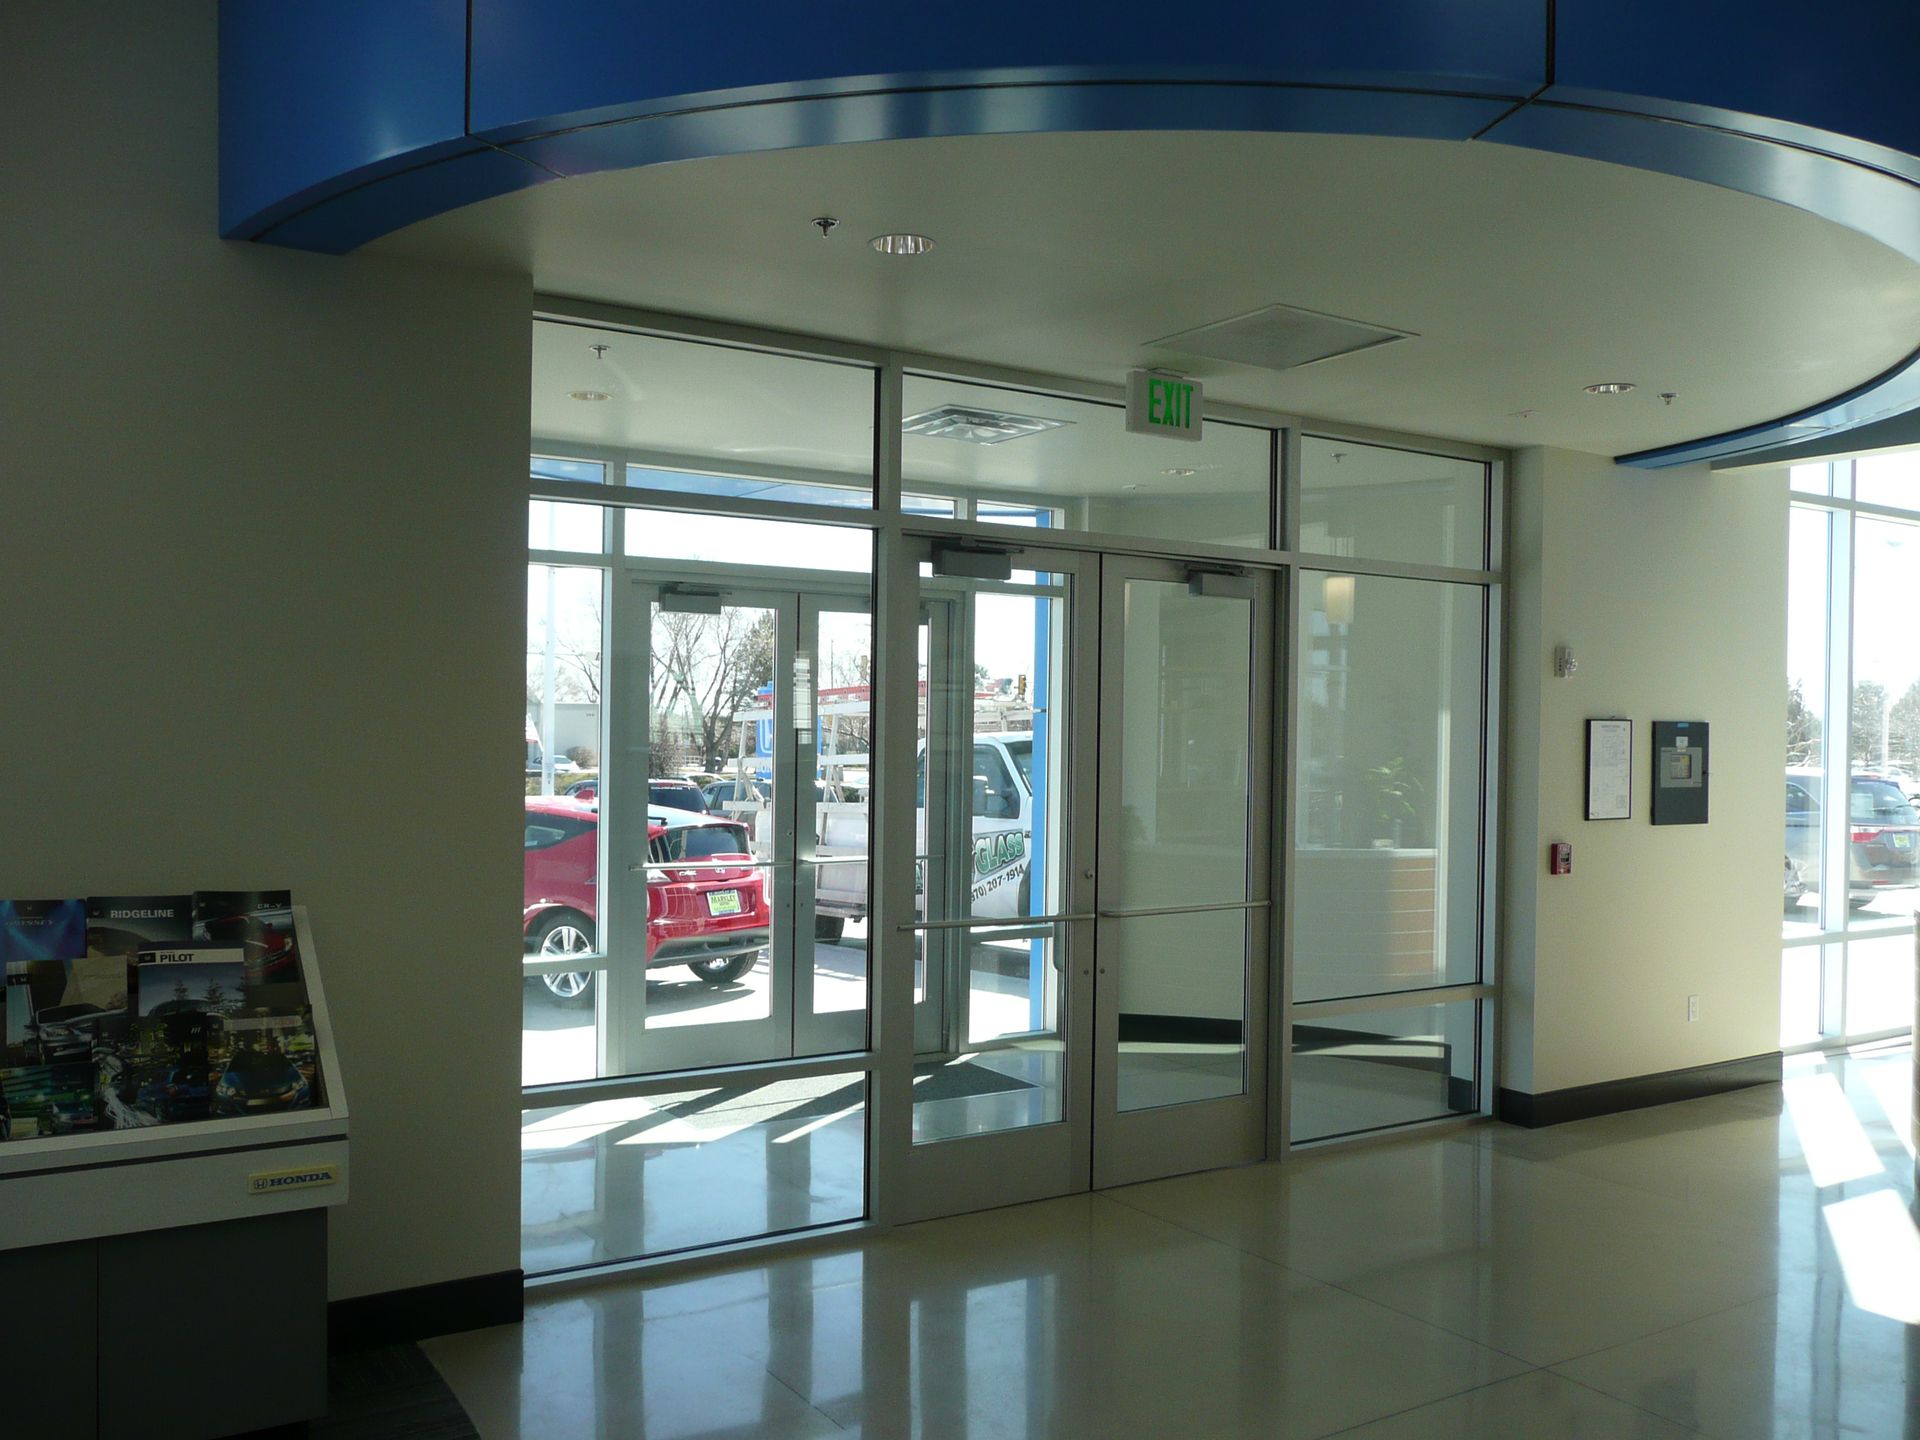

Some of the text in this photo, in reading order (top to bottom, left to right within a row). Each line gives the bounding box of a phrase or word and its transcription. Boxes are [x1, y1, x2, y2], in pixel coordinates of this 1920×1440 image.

[1148, 378, 1194, 429] EXIT
[974, 832, 1025, 875] GLASS
[987, 864, 1025, 892] 207-1914
[110, 909, 175, 919] RIDGELINE
[160, 953, 194, 962] PILOT
[269, 1172, 332, 1187] HONDA
